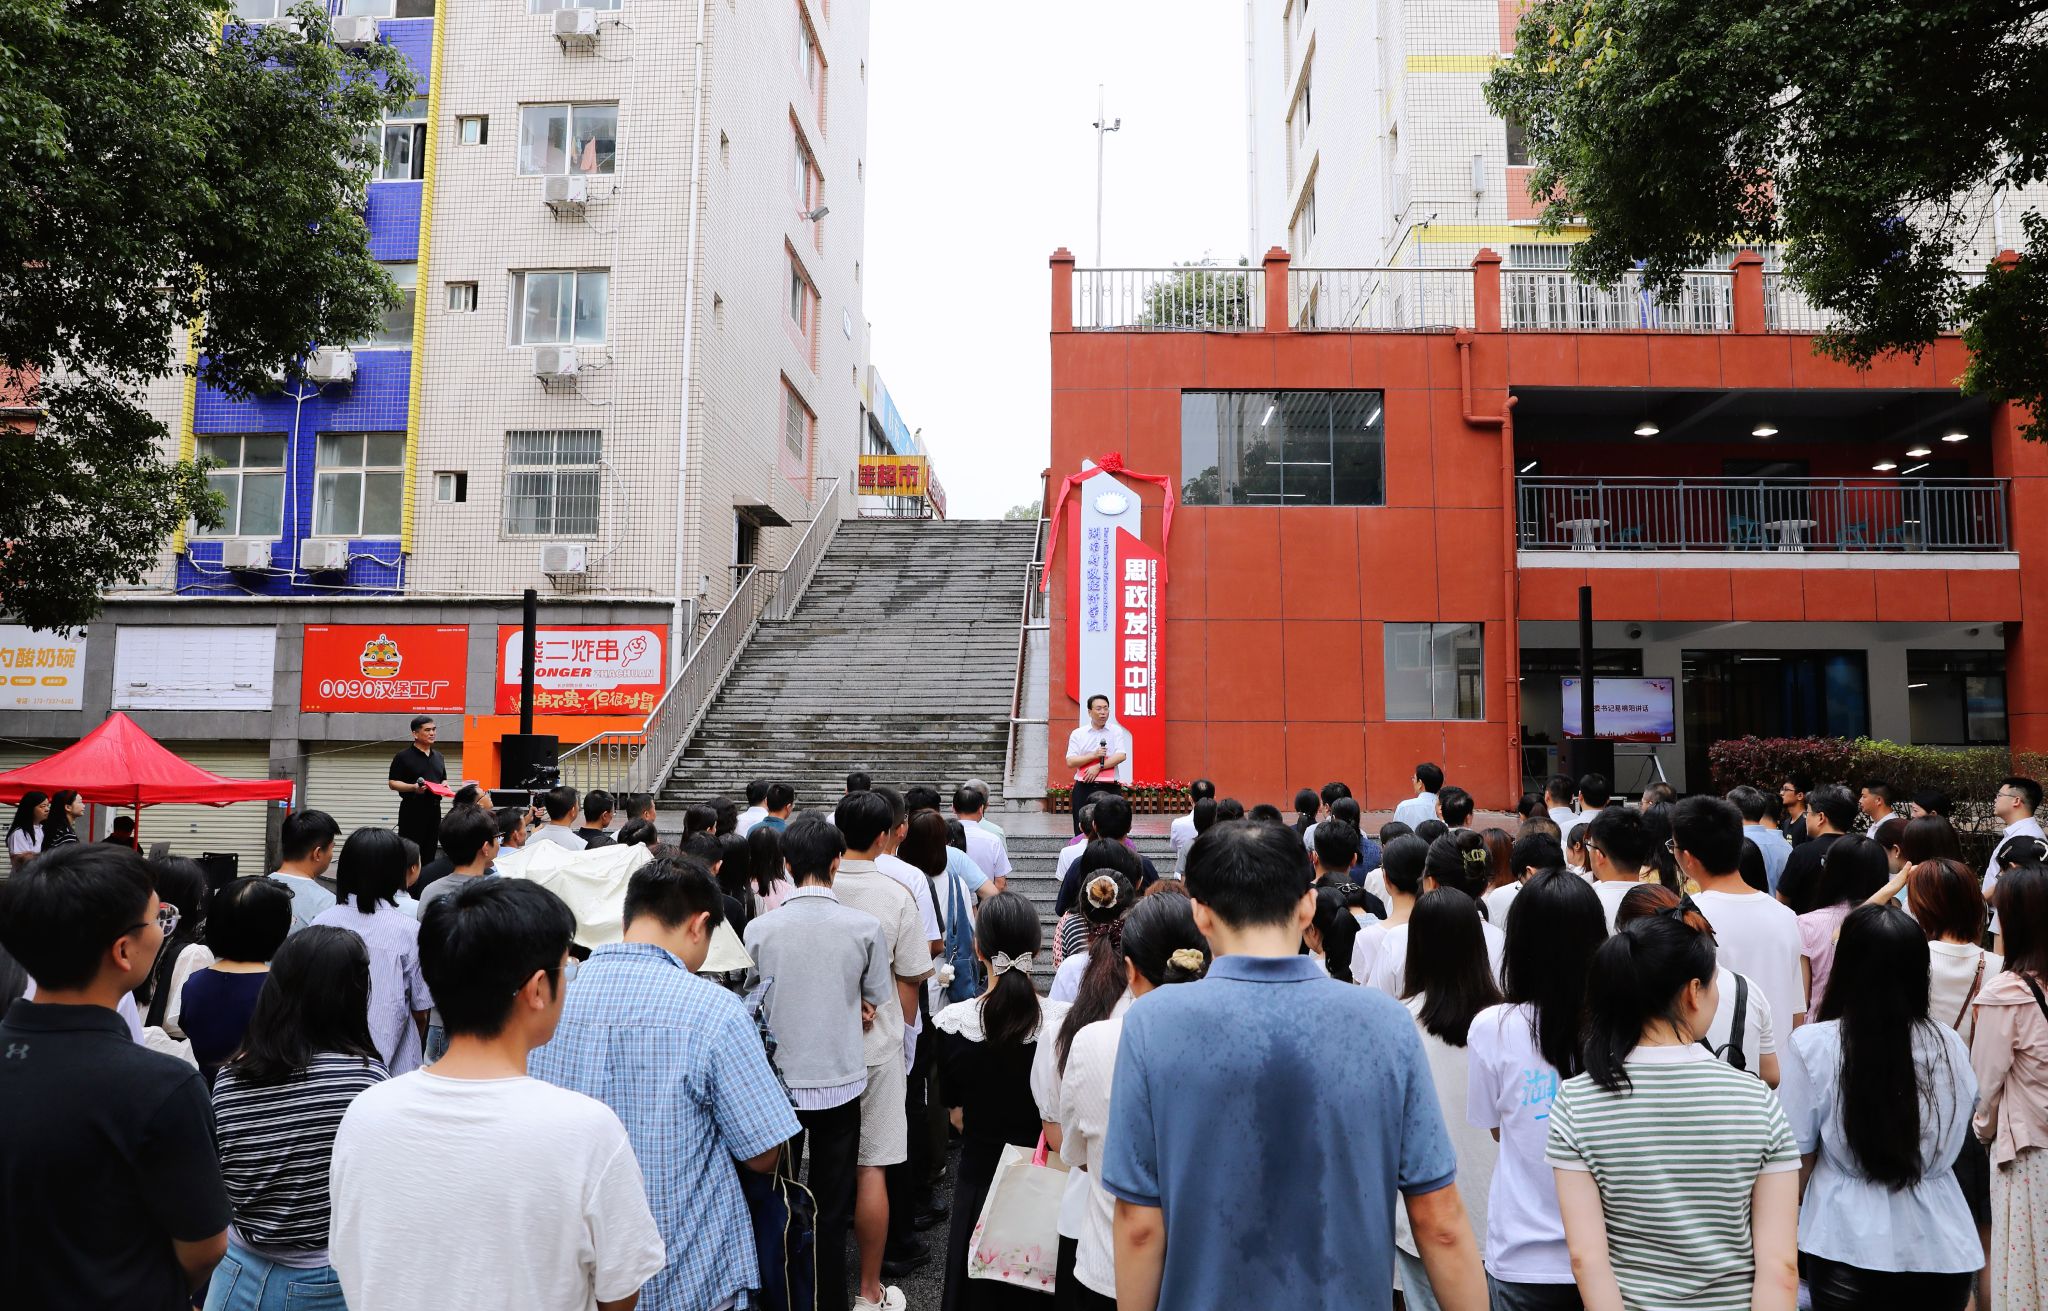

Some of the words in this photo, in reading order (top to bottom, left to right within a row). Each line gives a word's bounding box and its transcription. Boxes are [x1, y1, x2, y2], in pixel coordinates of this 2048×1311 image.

[1124, 559, 1148, 716] 思政发展中心
[518, 668, 592, 678] ONGER
[594, 669, 655, 678] ZHACHUAN
[319, 679, 450, 700] 0090汉堡工厂
[588, 689, 655, 712] 但很对胃
